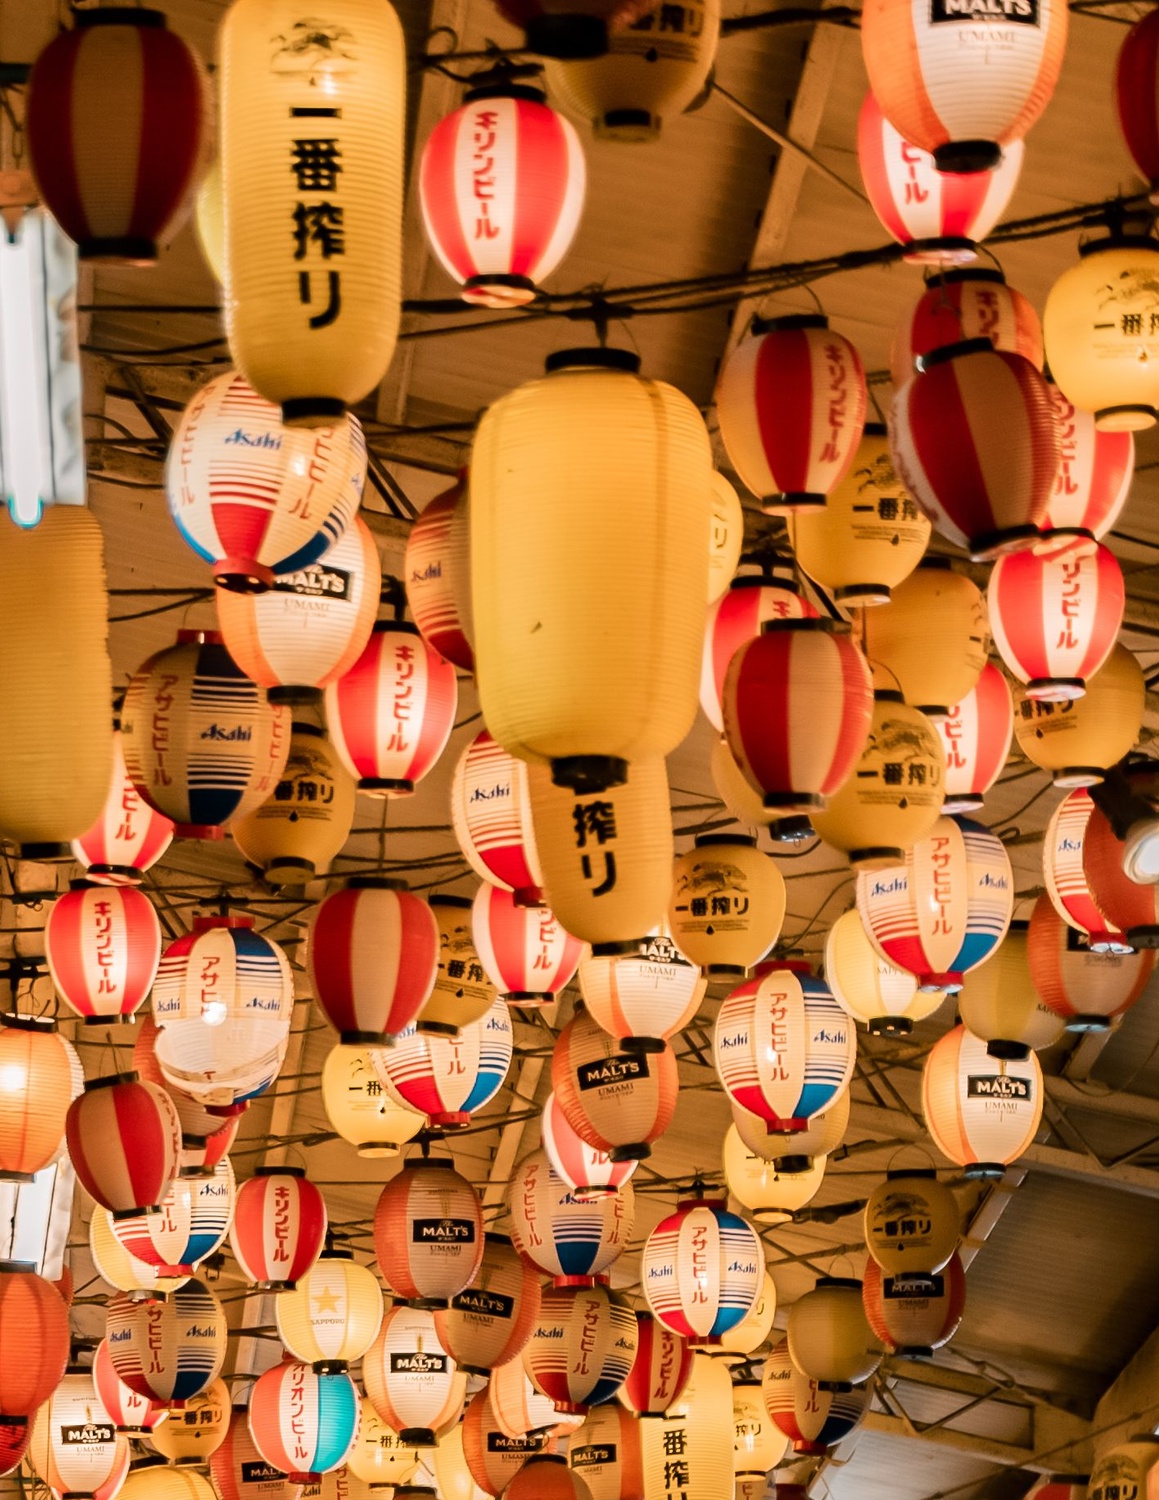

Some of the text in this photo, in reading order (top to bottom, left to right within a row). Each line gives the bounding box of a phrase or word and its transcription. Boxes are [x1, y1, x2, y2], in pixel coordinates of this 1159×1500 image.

[957, 29, 1016, 43] UMAMI
[472, 111, 501, 240] キリンビール
[289, 107, 345, 329] 一番搾り
[224, 428, 284, 452] Asahi
[853, 499, 922, 521] 一番搾
[284, 598, 330, 612] UMAMI
[1057, 556, 1081, 650] リンビール
[386, 644, 415, 754] キリンビール
[151, 674, 179, 787] アサヒビール
[200, 724, 252, 742] Asahi
[857, 763, 939, 785] 一番搾り
[273, 779, 335, 803] 番搾り
[470, 782, 511, 802] Asahi
[573, 801, 618, 896] 搾り
[871, 876, 908, 897] Asahi
[931, 837, 951, 935] アサヒビール
[675, 897, 749, 916] 一番搾り
[93, 900, 117, 996] キリンビール
[437, 960, 492, 984] 一番搾
[640, 966, 677, 978] UMAMI
[156, 998, 181, 1013] Asahi
[245, 997, 280, 1013] Asahi
[721, 1032, 748, 1049] Asahi
[771, 993, 789, 1082] アサヒビール
[814, 1030, 846, 1046] Asahi
[587, 1061, 641, 1080] MALT'S
[348, 1079, 384, 1097] 一番
[977, 1080, 1026, 1096] MALT'S
[985, 1102, 1017, 1111] UMAMI
[199, 1182, 229, 1198] Asahi
[274, 1186, 290, 1263] キリンビール
[422, 1225, 469, 1238] MALT'S
[872, 1220, 931, 1237] 一番搾り
[429, 1244, 462, 1254] UMAMI
[648, 1264, 673, 1278] Asahi
[692, 1226, 708, 1305] アサヒビール
[728, 1260, 757, 1275] Asahi
[459, 1295, 505, 1311] MALT'S
[147, 1303, 165, 1375] サヒビール
[186, 1325, 216, 1339] Asahi
[534, 1327, 565, 1340] Asahi
[573, 1300, 600, 1376] アサヒビール
[397, 1358, 443, 1371] MALT'S
[68, 1428, 111, 1441] MALT'S
[76, 1446, 105, 1454] UMAMI
